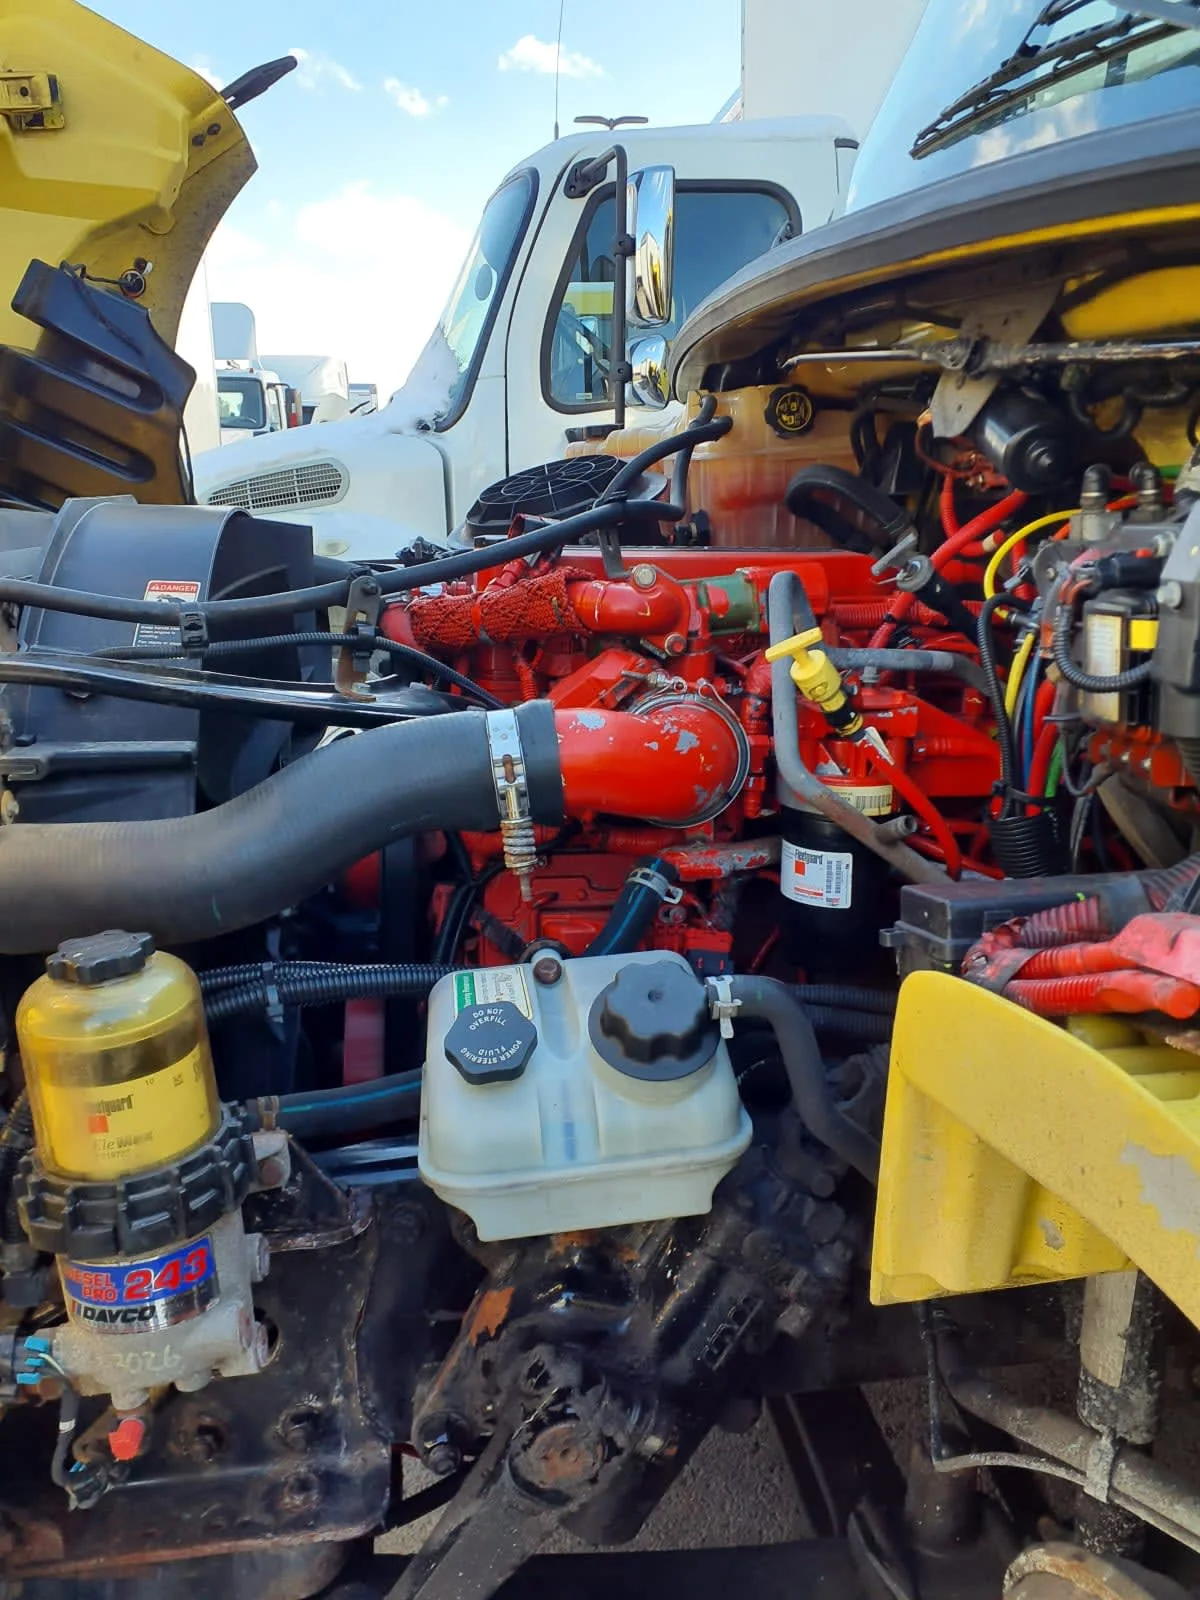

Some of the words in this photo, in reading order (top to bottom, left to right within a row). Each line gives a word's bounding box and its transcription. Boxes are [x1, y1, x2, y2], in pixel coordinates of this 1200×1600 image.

[160, 584, 197, 592] DANGER
[472, 1010, 484, 1019] DO
[469, 1015, 507, 1031] OVERFILL
[460, 1047, 498, 1065] STEERING
[478, 1045, 507, 1057] FLUID
[500, 1040, 523, 1061] POWER
[82, 1286, 118, 1302] PRO
[124, 1247, 208, 1301] 243
